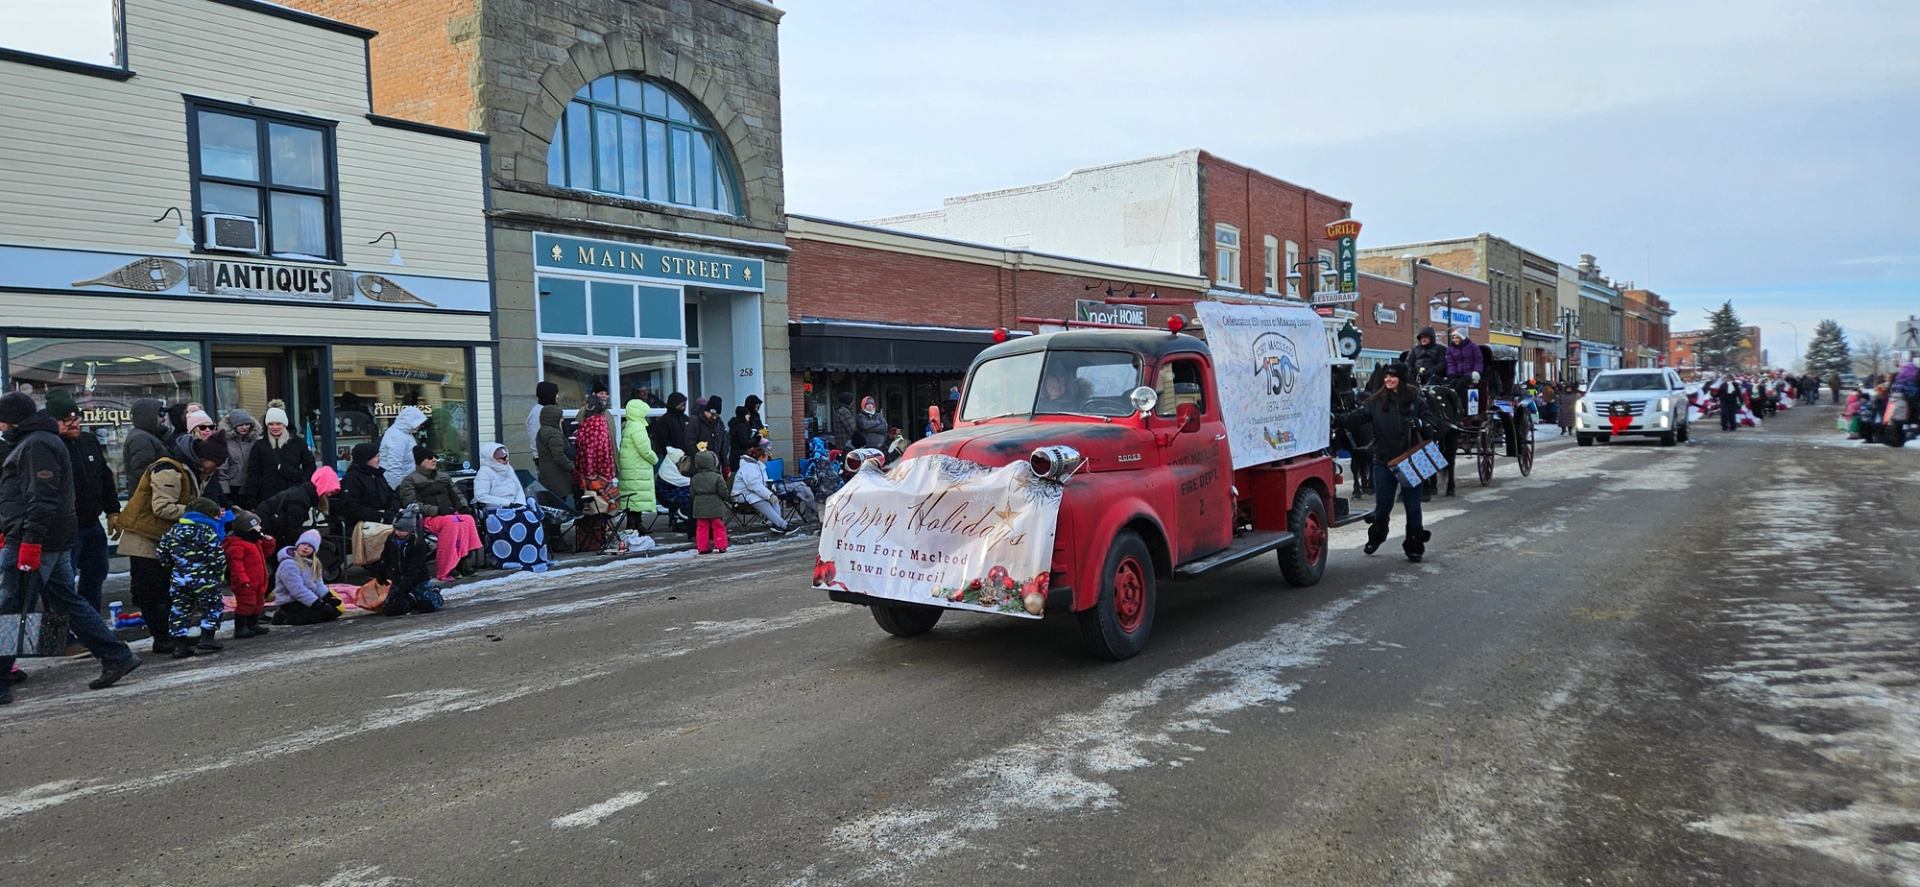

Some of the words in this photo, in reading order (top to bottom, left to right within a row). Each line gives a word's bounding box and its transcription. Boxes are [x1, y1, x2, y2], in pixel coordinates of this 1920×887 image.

[1327, 223, 1358, 238] GRILL
[577, 246, 645, 271] MAIN
[660, 255, 733, 281] STREET
[1342, 237, 1352, 283] CAFE
[215, 263, 333, 294] ANTIQUES
[1119, 308, 1144, 325] HOME
[740, 367, 754, 377] 258
[1263, 354, 1296, 396] 150
[79, 405, 133, 427] ntiqu
[1118, 453, 1142, 463] DODGE
[1180, 478, 1199, 497] FIRE
[1199, 498, 1206, 516] 2
[824, 486, 898, 542] Happy
[906, 490, 1028, 552] Holidays
[836, 538, 866, 554] From
[872, 543, 904, 559] Fort
[910, 549, 968, 566] Macleod
[850, 560, 884, 576] Town
[889, 567, 946, 585] Council
